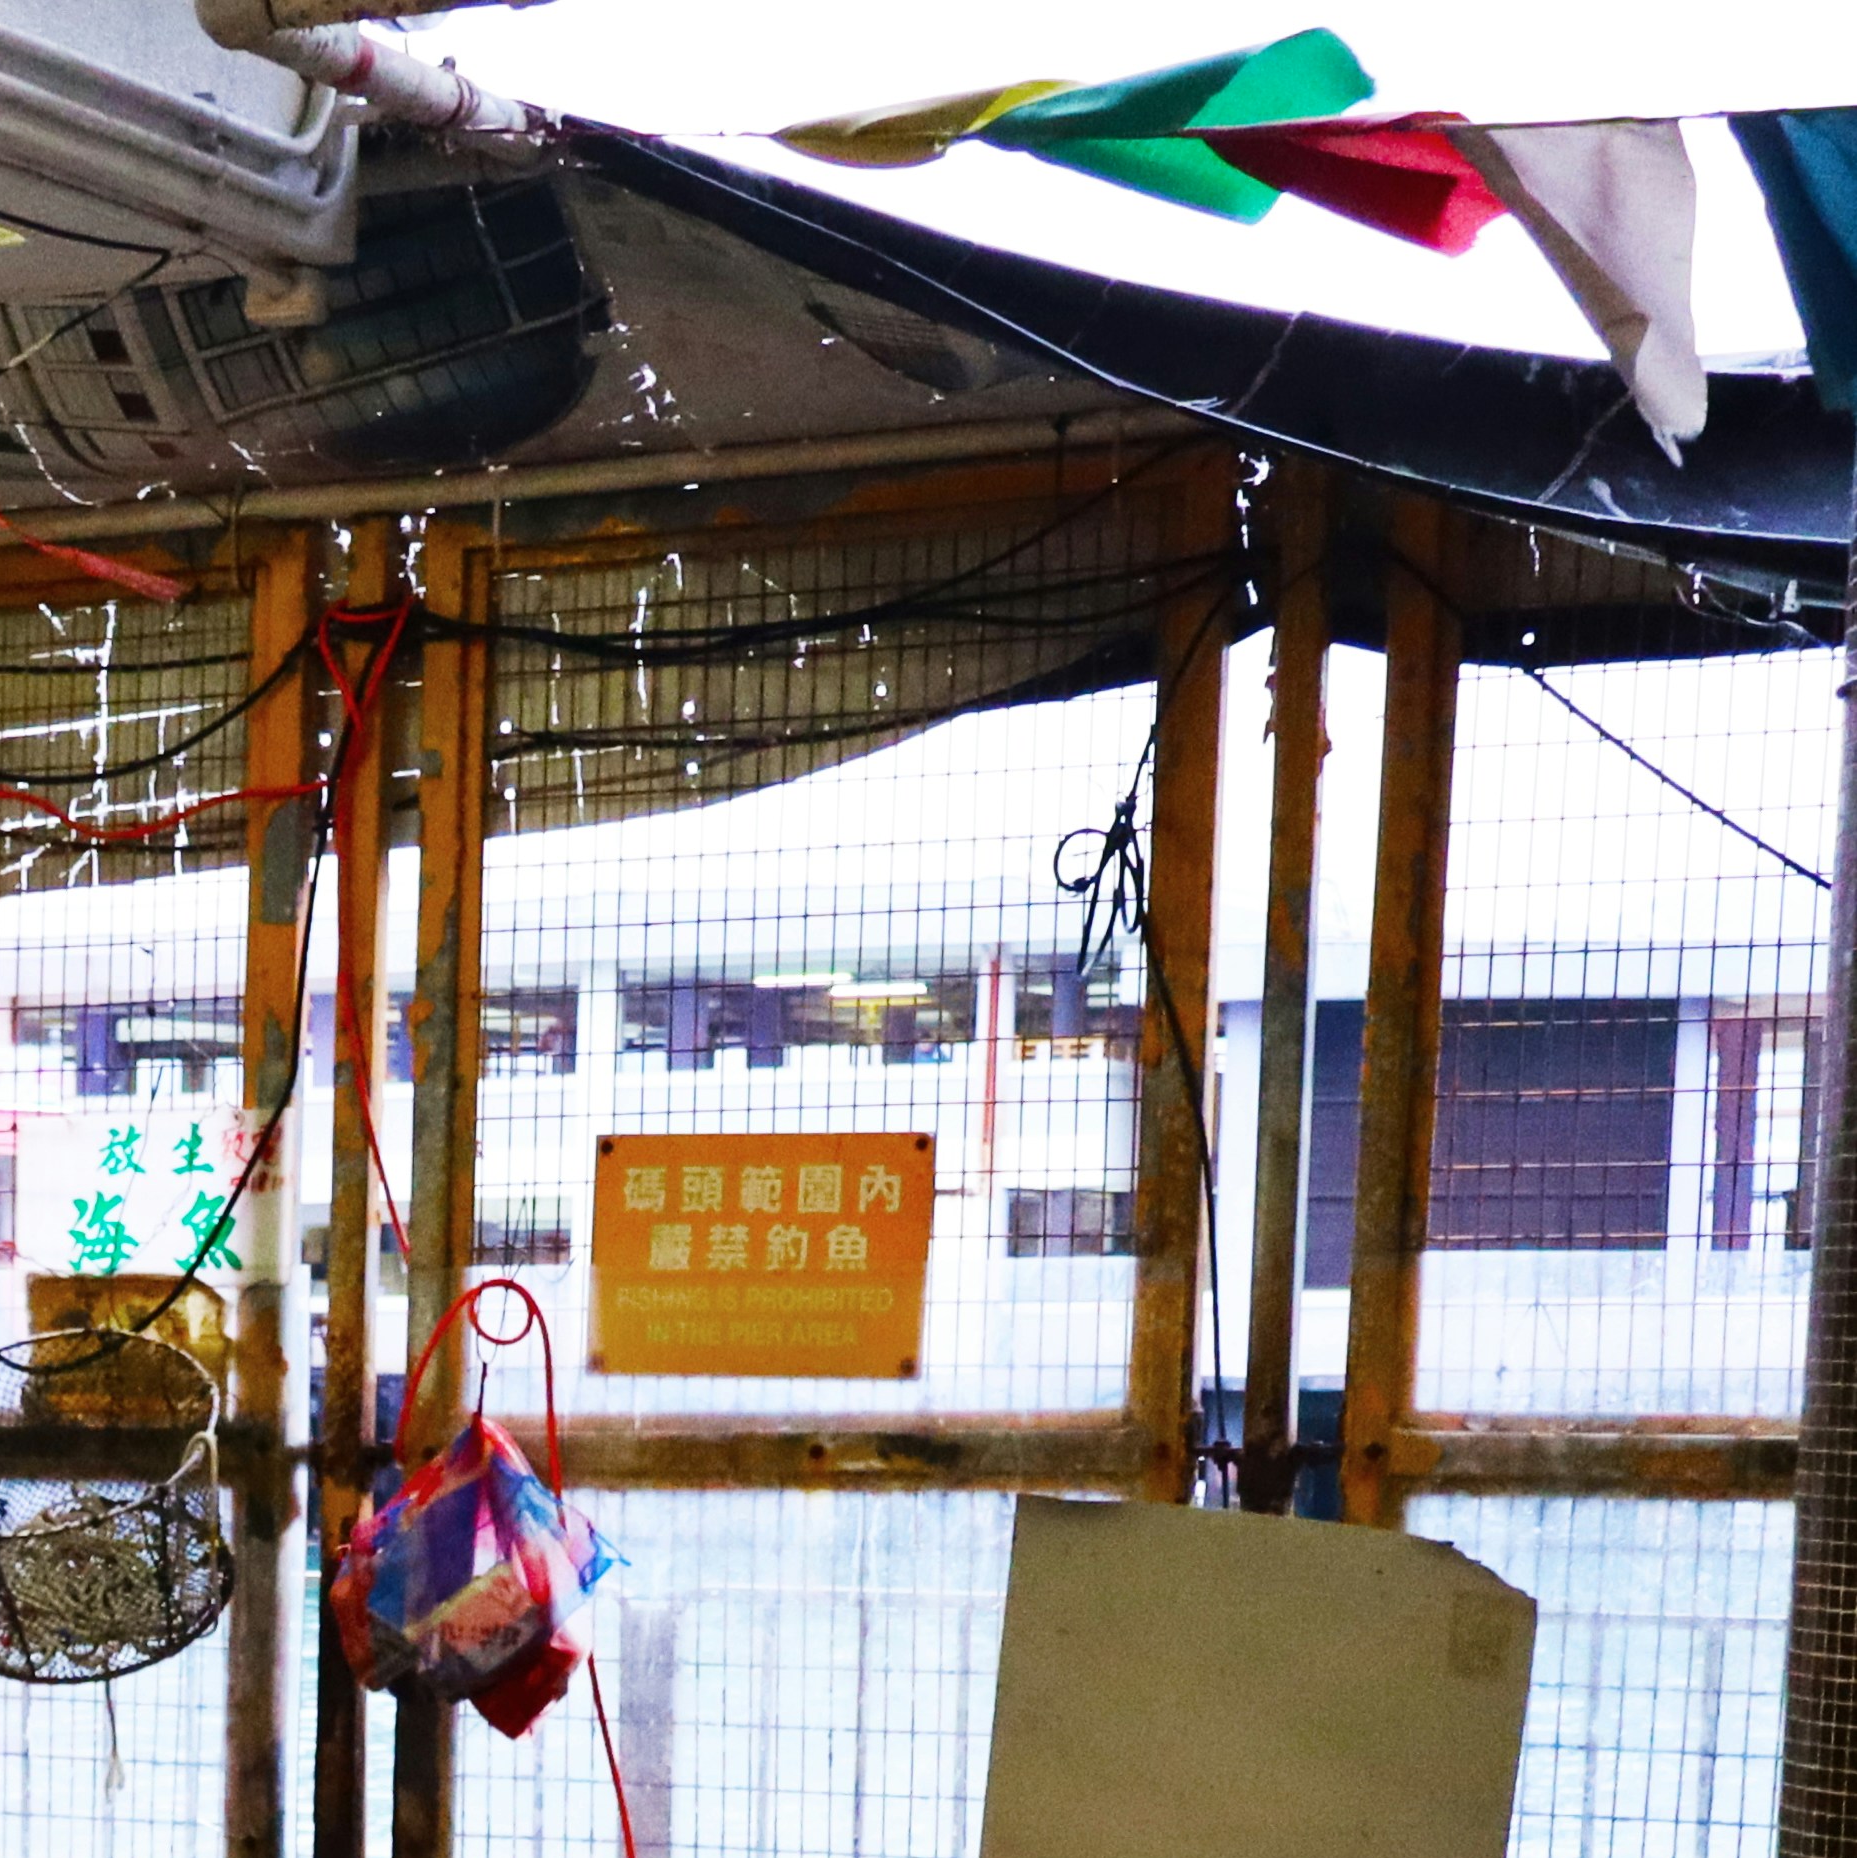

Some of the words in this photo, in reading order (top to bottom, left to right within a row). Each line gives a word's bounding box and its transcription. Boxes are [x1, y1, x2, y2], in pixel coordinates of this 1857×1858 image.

[98, 1121, 215, 1175] 放生
[624, 1163, 903, 1214] 碼頭範圍內
[68, 1190, 242, 1277] 海魚
[648, 1222, 869, 1273] 嚴禁釣魚
[616, 1285, 710, 1312] FISHING
[717, 1285, 740, 1312] IS
[745, 1285, 894, 1313] PROHIBITED
[676, 1320, 722, 1345] THE
[789, 1321, 858, 1346] AREA
